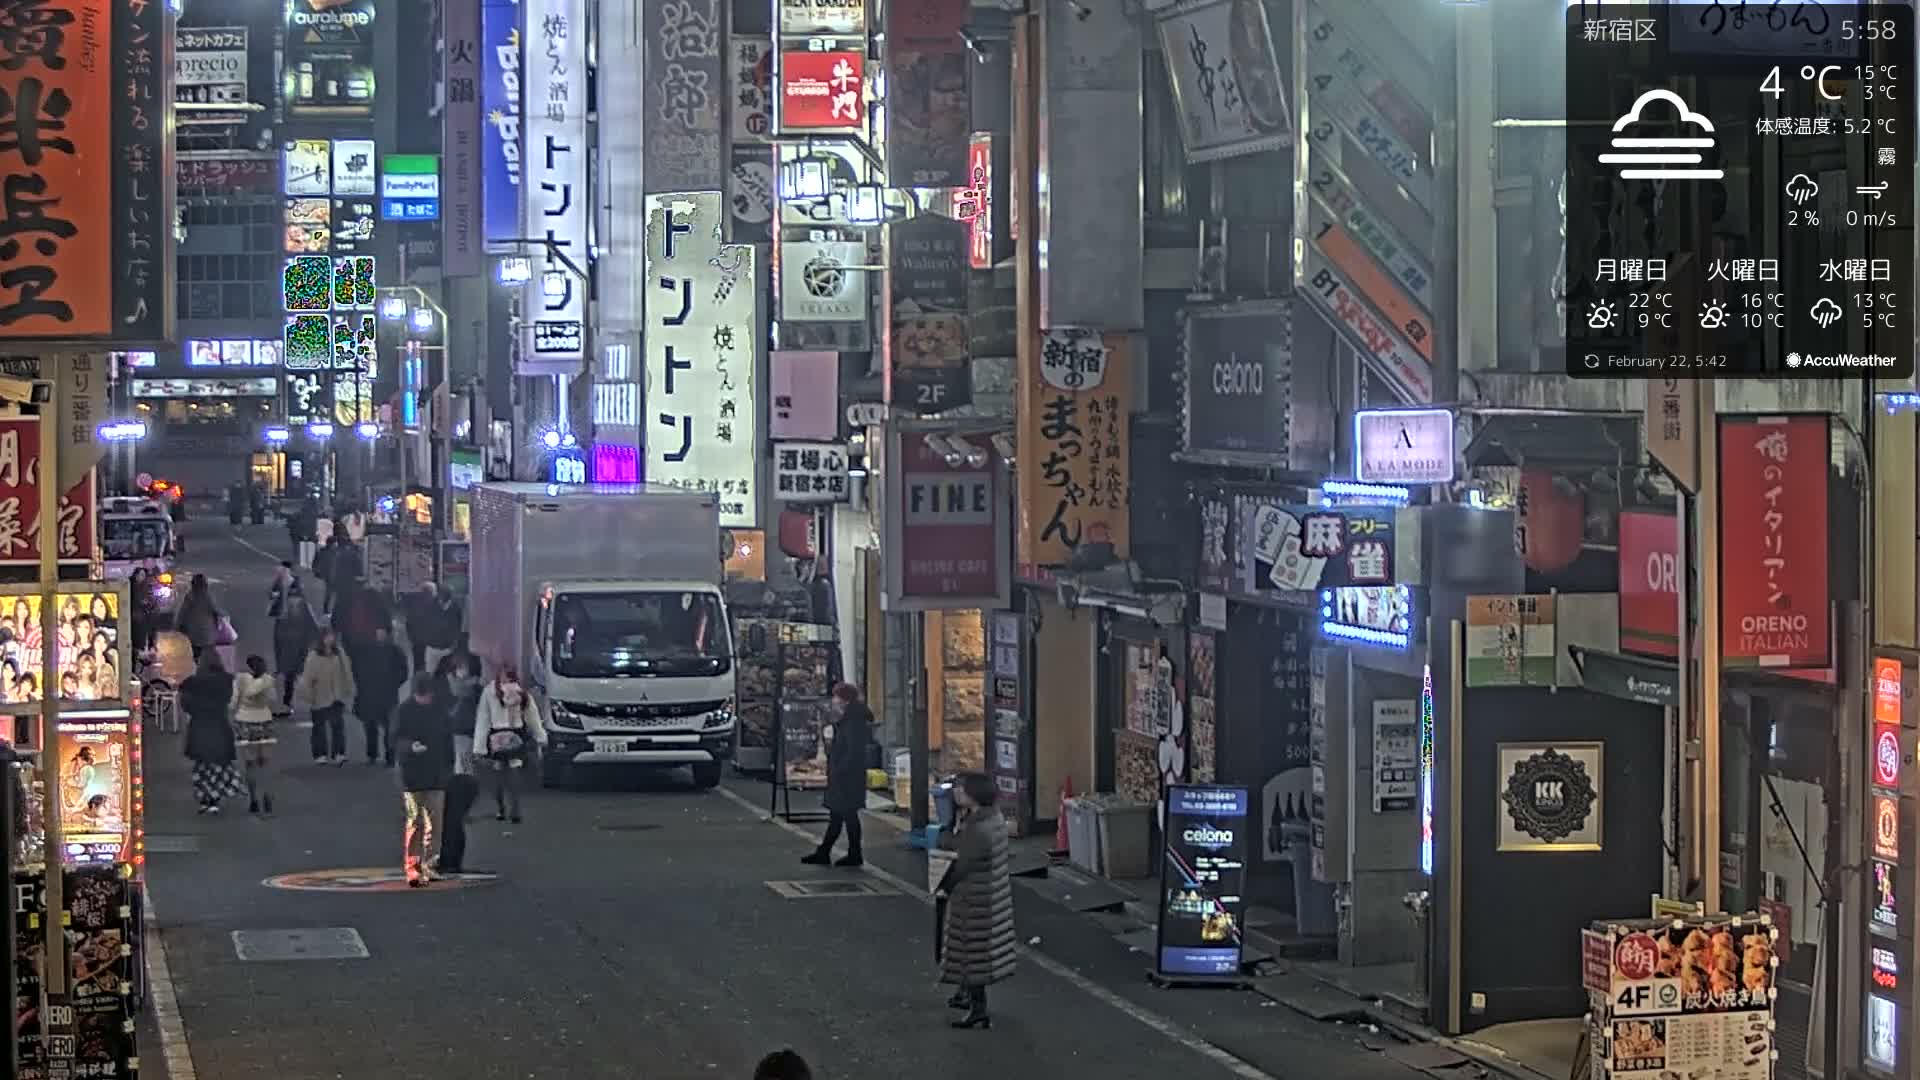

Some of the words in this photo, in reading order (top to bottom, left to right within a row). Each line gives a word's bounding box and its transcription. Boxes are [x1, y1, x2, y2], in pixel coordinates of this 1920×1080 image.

[809, 39, 836, 52] 2F
[1312, 269, 1340, 298] B1
[659, 207, 692, 463] トントン
[1045, 340, 1104, 387] 新宿の
[1212, 352, 1263, 395] celona
[72, 353, 93, 444] 通り一番街
[917, 384, 946, 403] 2F
[779, 448, 844, 470] 酒場心
[1040, 396, 1086, 547] まっちゃん
[779, 474, 844, 493] 新宿本店
[911, 485, 986, 513] FINE
[1350, 519, 1389, 535] フリー
[1754, 430, 1789, 603] 俺のイタリアン
[1741, 616, 1808, 633] ORENO
[1740, 634, 1809, 651] ITALIAN
[1535, 782, 1565, 799] KK
[1183, 828, 1233, 842] celona
[1617, 986, 1650, 1009] 4F
[48, 1006, 72, 1024] ERO
